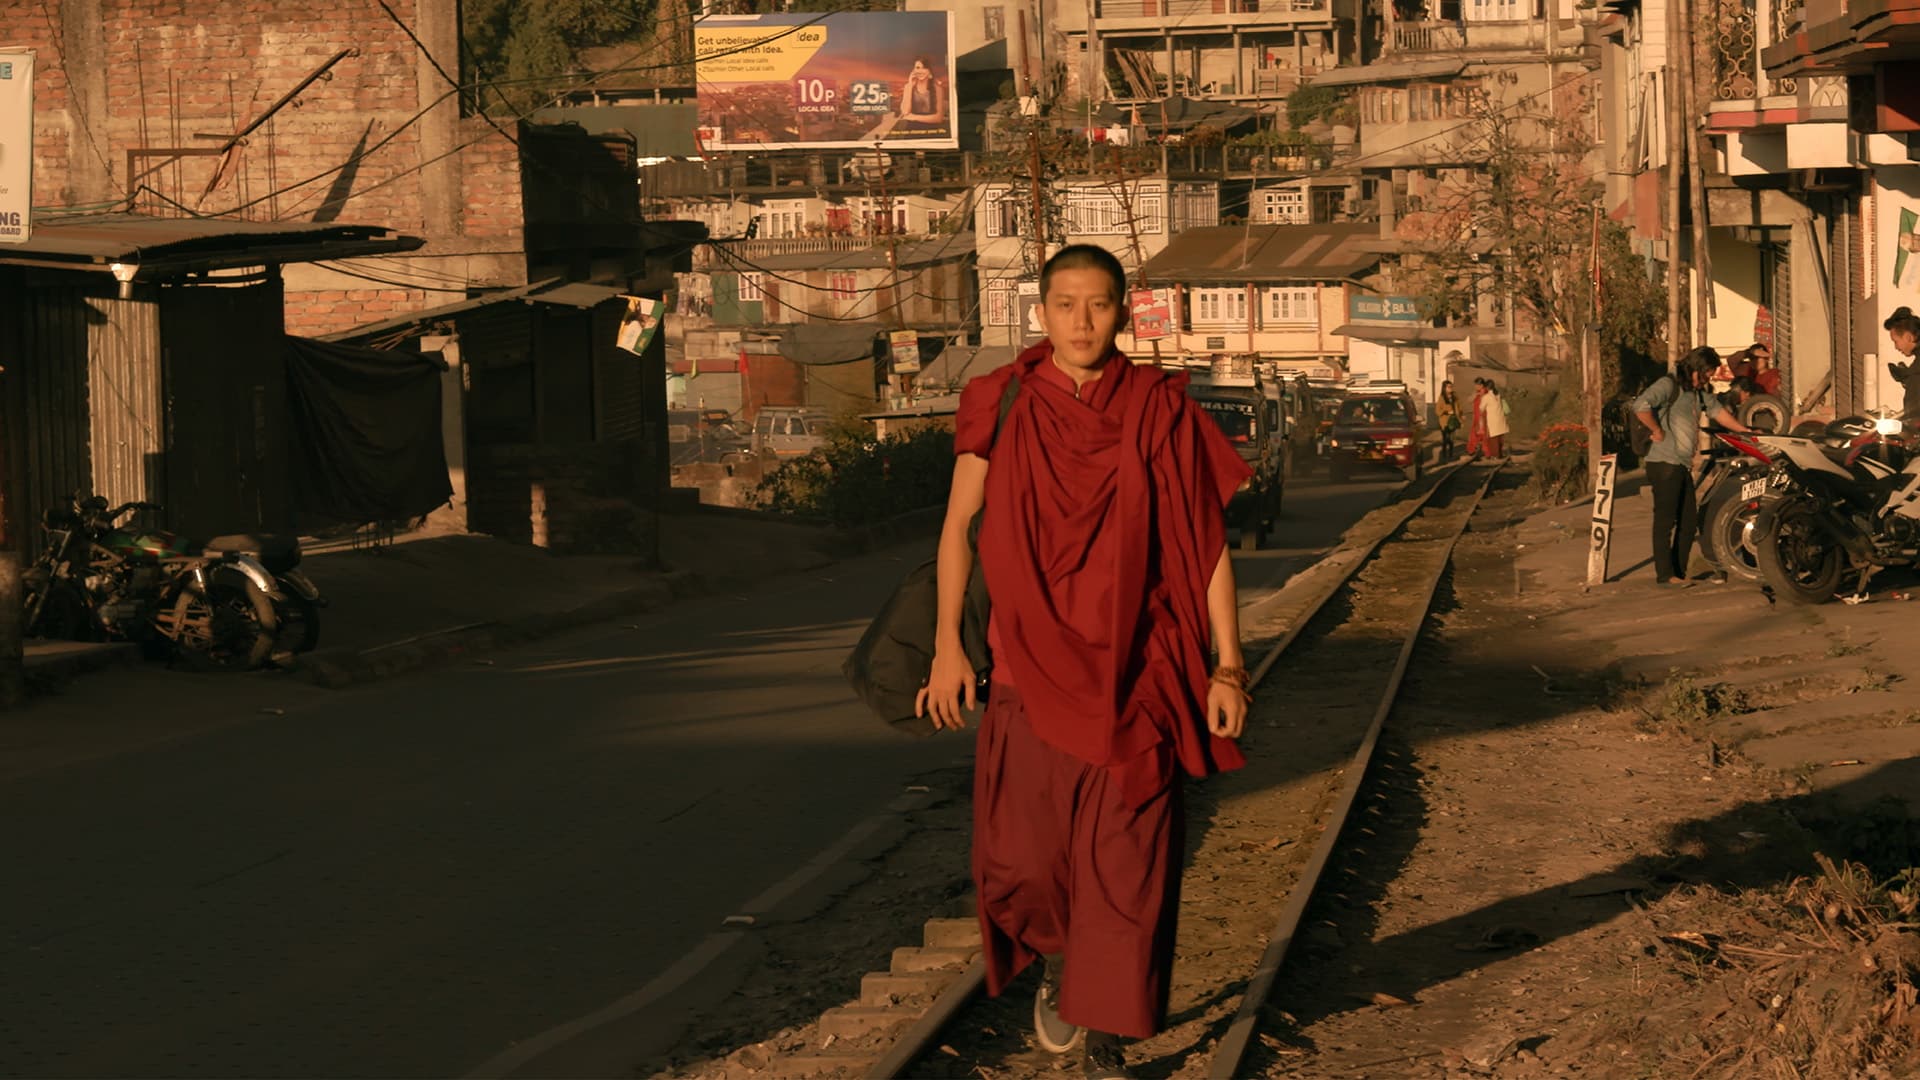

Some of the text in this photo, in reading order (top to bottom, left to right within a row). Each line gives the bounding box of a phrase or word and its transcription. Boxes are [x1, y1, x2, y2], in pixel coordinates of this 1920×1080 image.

[697, 36, 714, 46] Get
[763, 46, 784, 54] Idea.
[1392, 303, 1417, 314] BAJA
